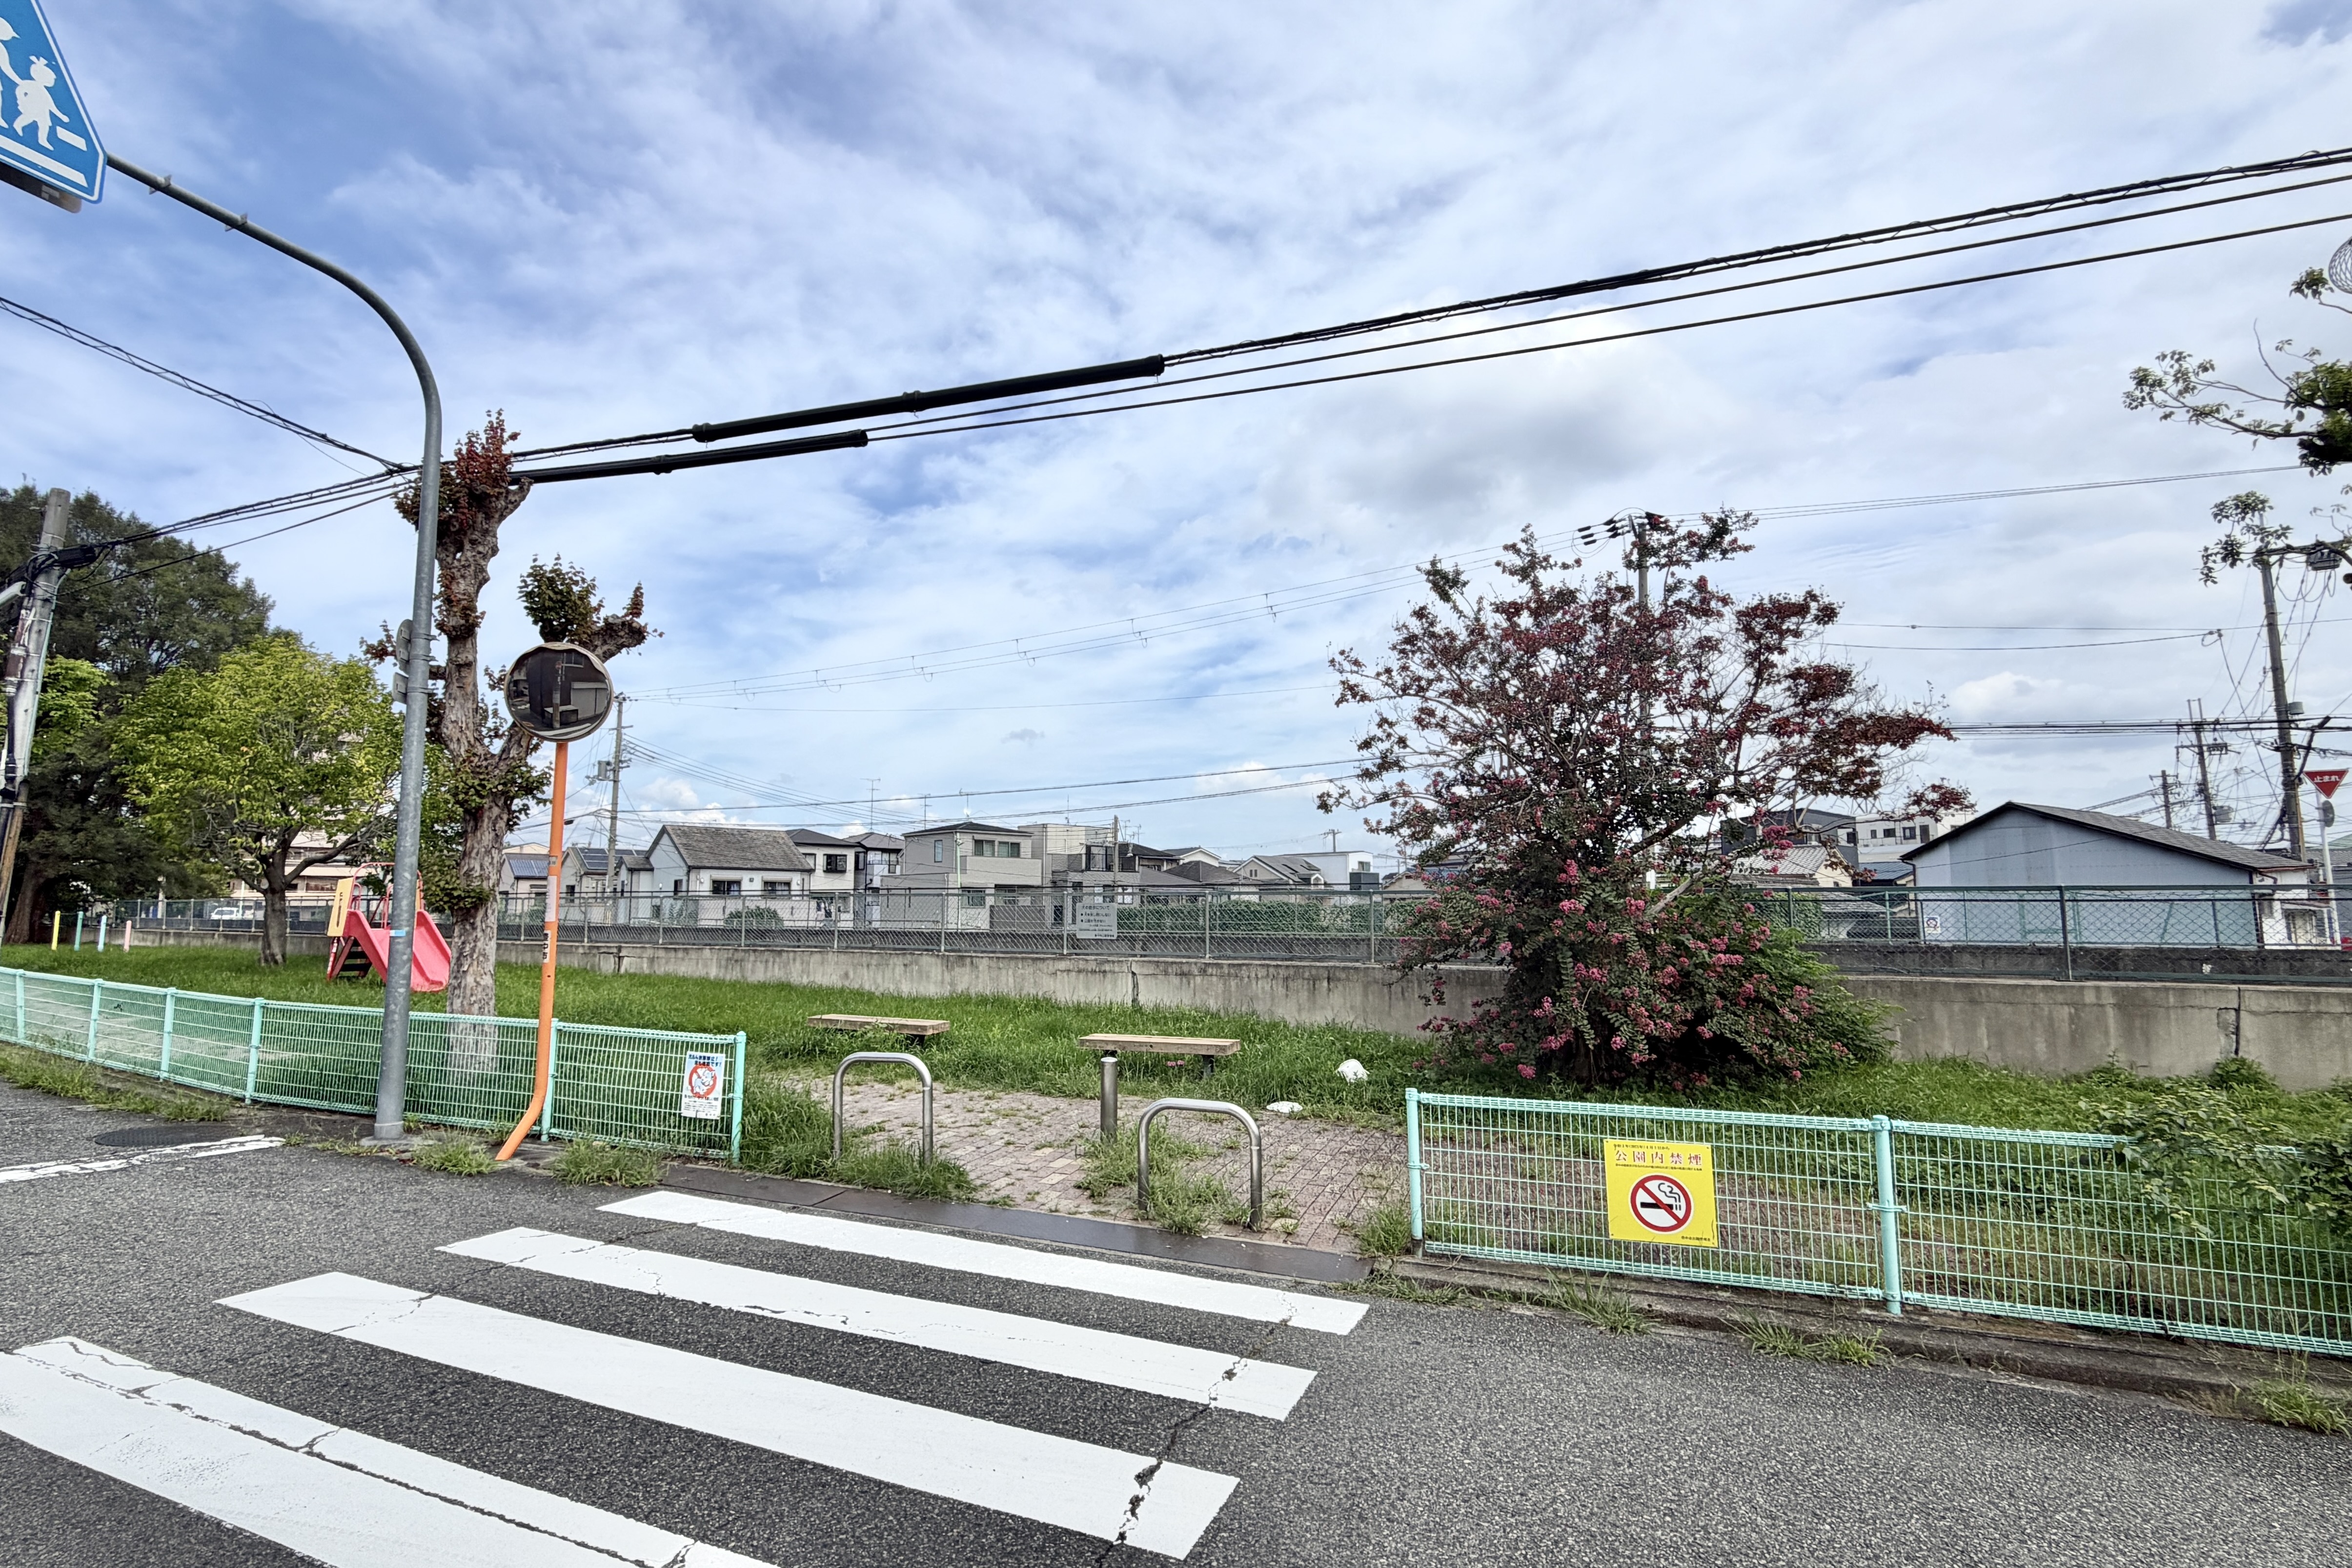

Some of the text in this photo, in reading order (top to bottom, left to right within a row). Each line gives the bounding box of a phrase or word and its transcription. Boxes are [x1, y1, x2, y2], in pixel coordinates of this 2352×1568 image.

[1615, 1150, 1702, 1166] 公園内禁煙
